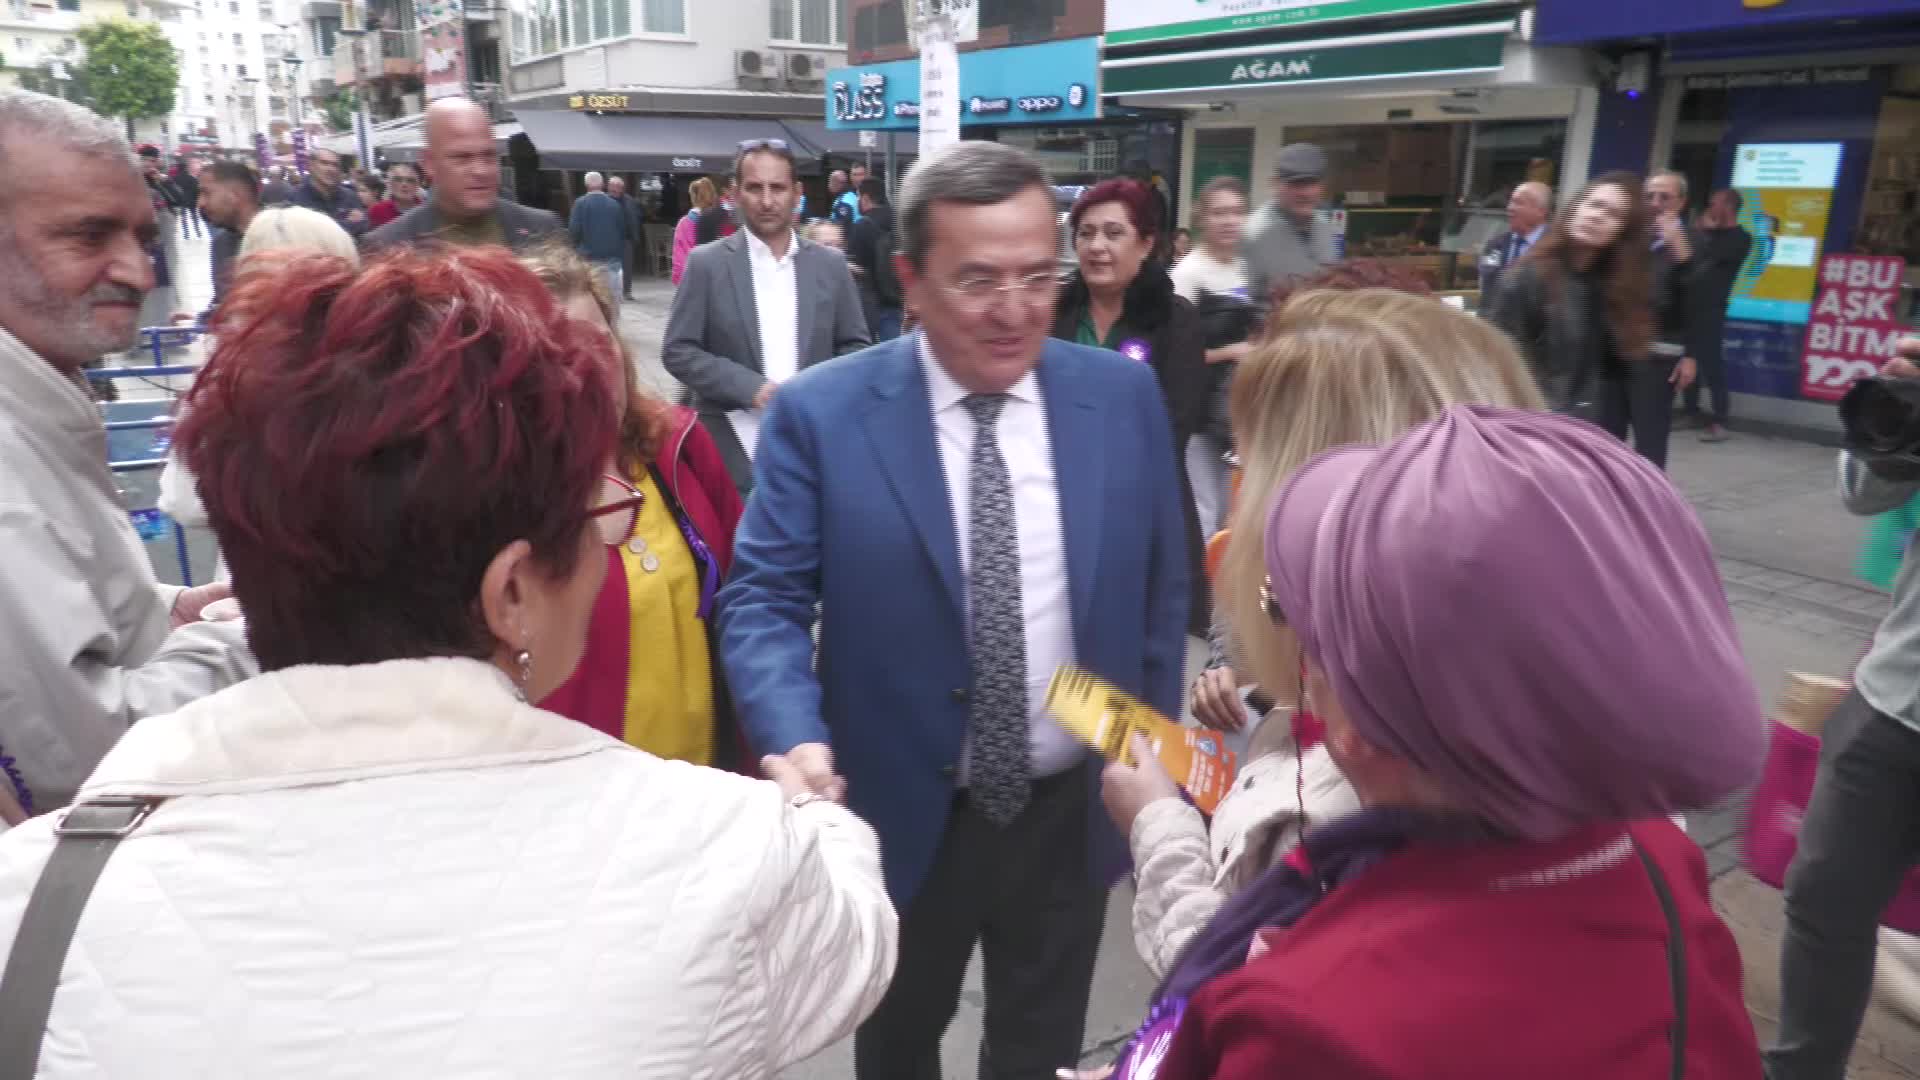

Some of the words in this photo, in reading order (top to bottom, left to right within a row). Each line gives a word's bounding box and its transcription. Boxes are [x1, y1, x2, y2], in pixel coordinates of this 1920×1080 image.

[1230, 58, 1311, 81] AĞAM
[1823, 257, 1900, 289] #BU
[1816, 288, 1894, 321] AŞK
[1809, 317, 1920, 357] BİTM
